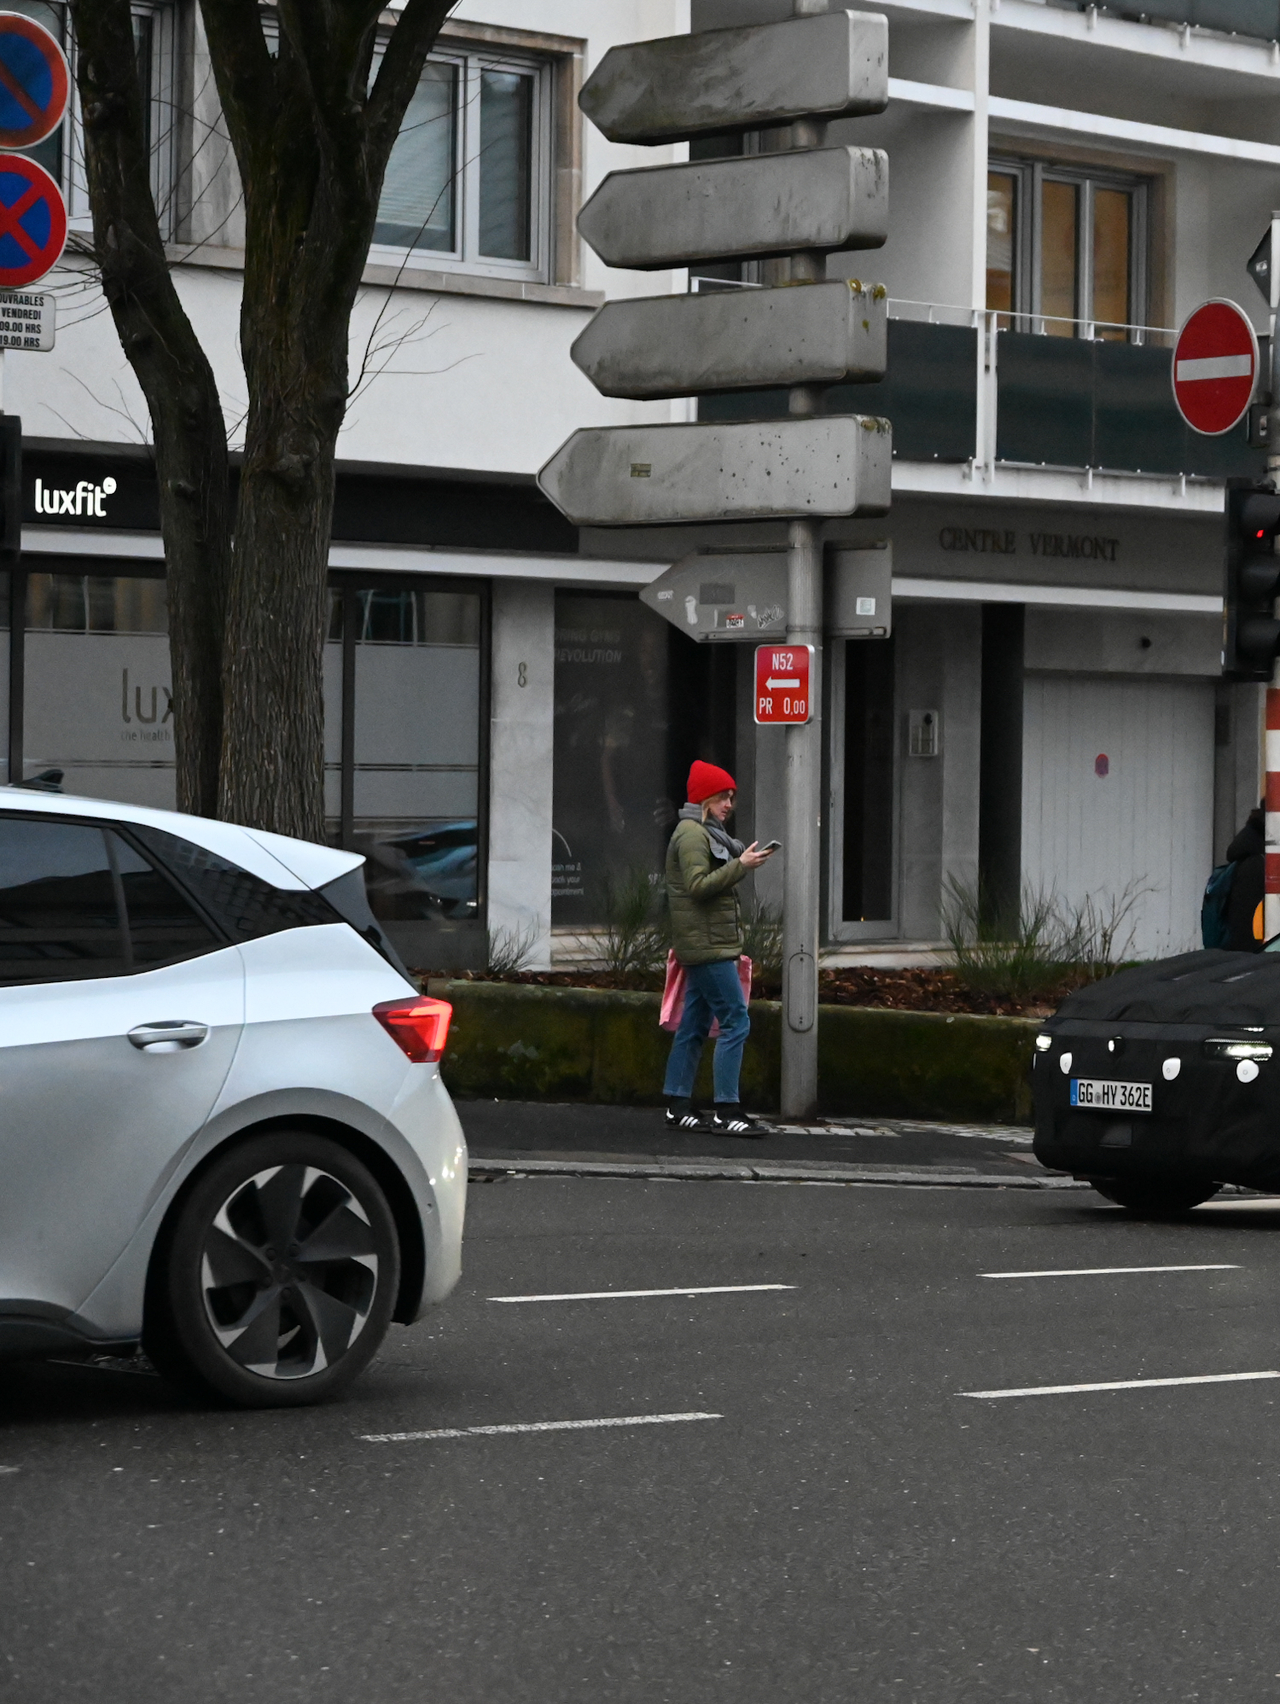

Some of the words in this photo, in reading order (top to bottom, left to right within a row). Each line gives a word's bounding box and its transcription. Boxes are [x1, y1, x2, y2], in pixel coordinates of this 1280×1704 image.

[1, 307, 41, 320] VENDREDI
[25, 323, 41, 334] HRS
[24, 336, 40, 348] HRS
[35, 478, 107, 517] luxfit
[939, 526, 1016, 554] CENTRE
[1029, 532, 1120, 561] VERMONT
[772, 653, 793, 670] N52
[517, 661, 527, 688] 8
[759, 697, 773, 714] PR
[121, 730, 137, 741] the
[140, 729, 171, 742] health
[1078, 1082, 1094, 1104] GG
[1102, 1084, 1118, 1106] HY
[1120, 1085, 1151, 1108] 362E
